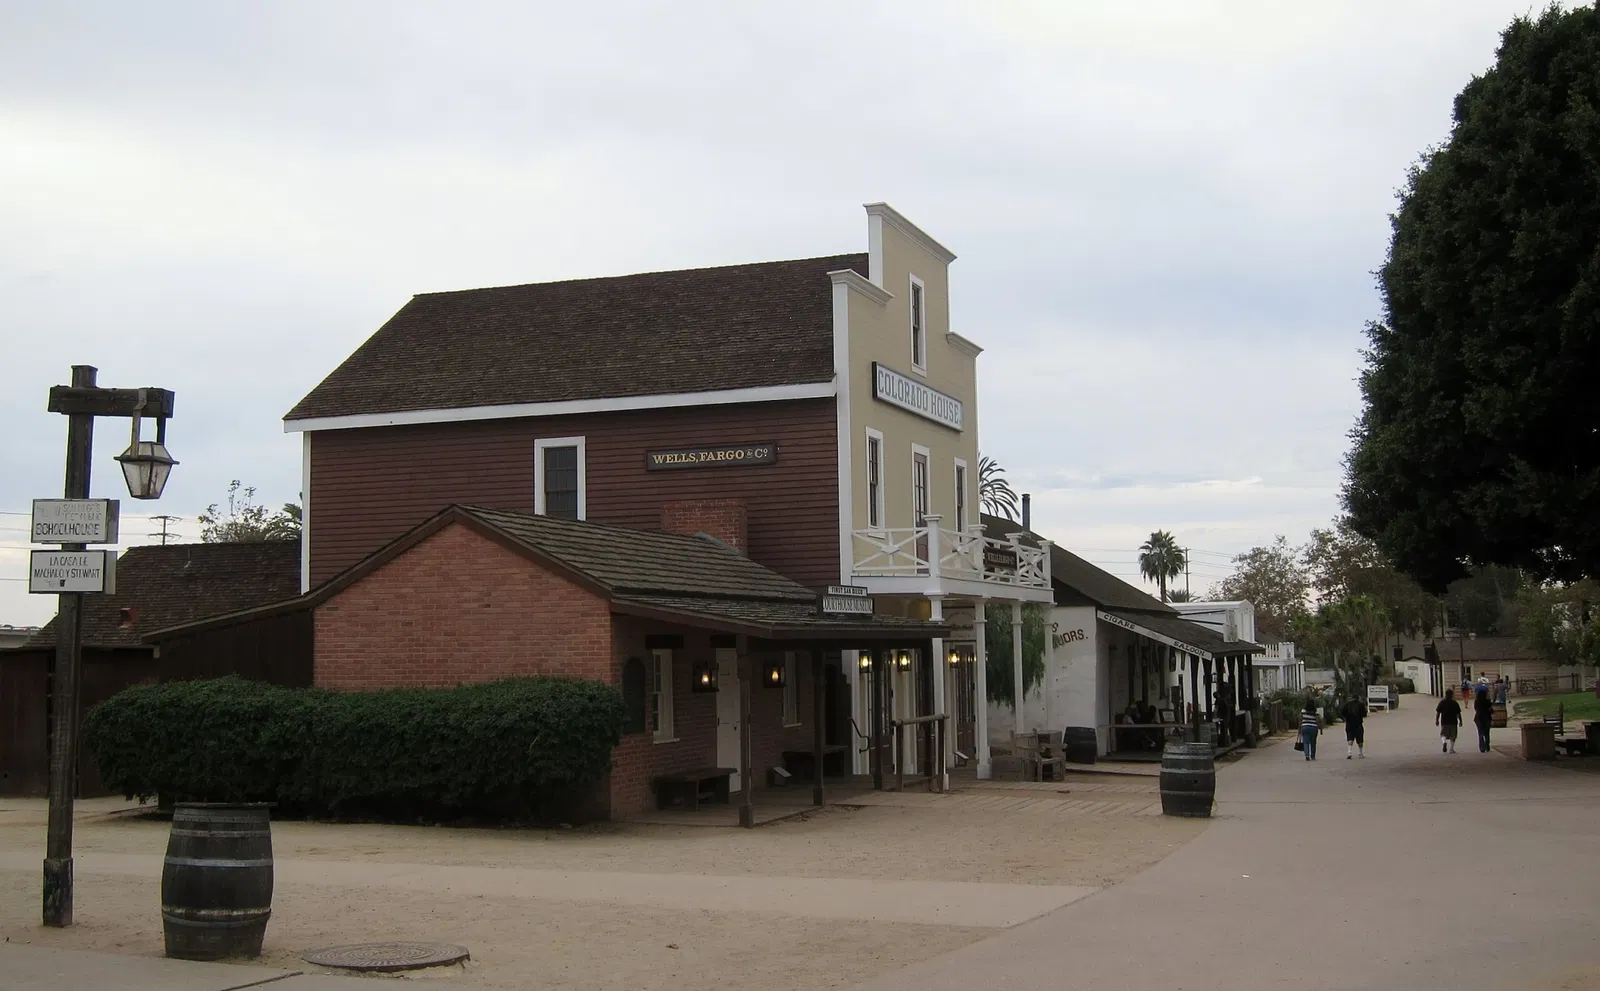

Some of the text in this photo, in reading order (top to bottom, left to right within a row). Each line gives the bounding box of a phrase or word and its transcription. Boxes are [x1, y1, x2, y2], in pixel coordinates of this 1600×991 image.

[877, 369, 928, 412] COLORADO
[700, 449, 745, 461] FARGO
[36, 523, 100, 535] SCHOOLHOUSE
[49, 556, 59, 566] LA
[60, 556, 78, 567] CASA
[65, 568, 70, 578] Y
[71, 568, 100, 578] STEWART
[831, 586, 843, 594] FIRST
[823, 597, 853, 611] OURTHOUSE
